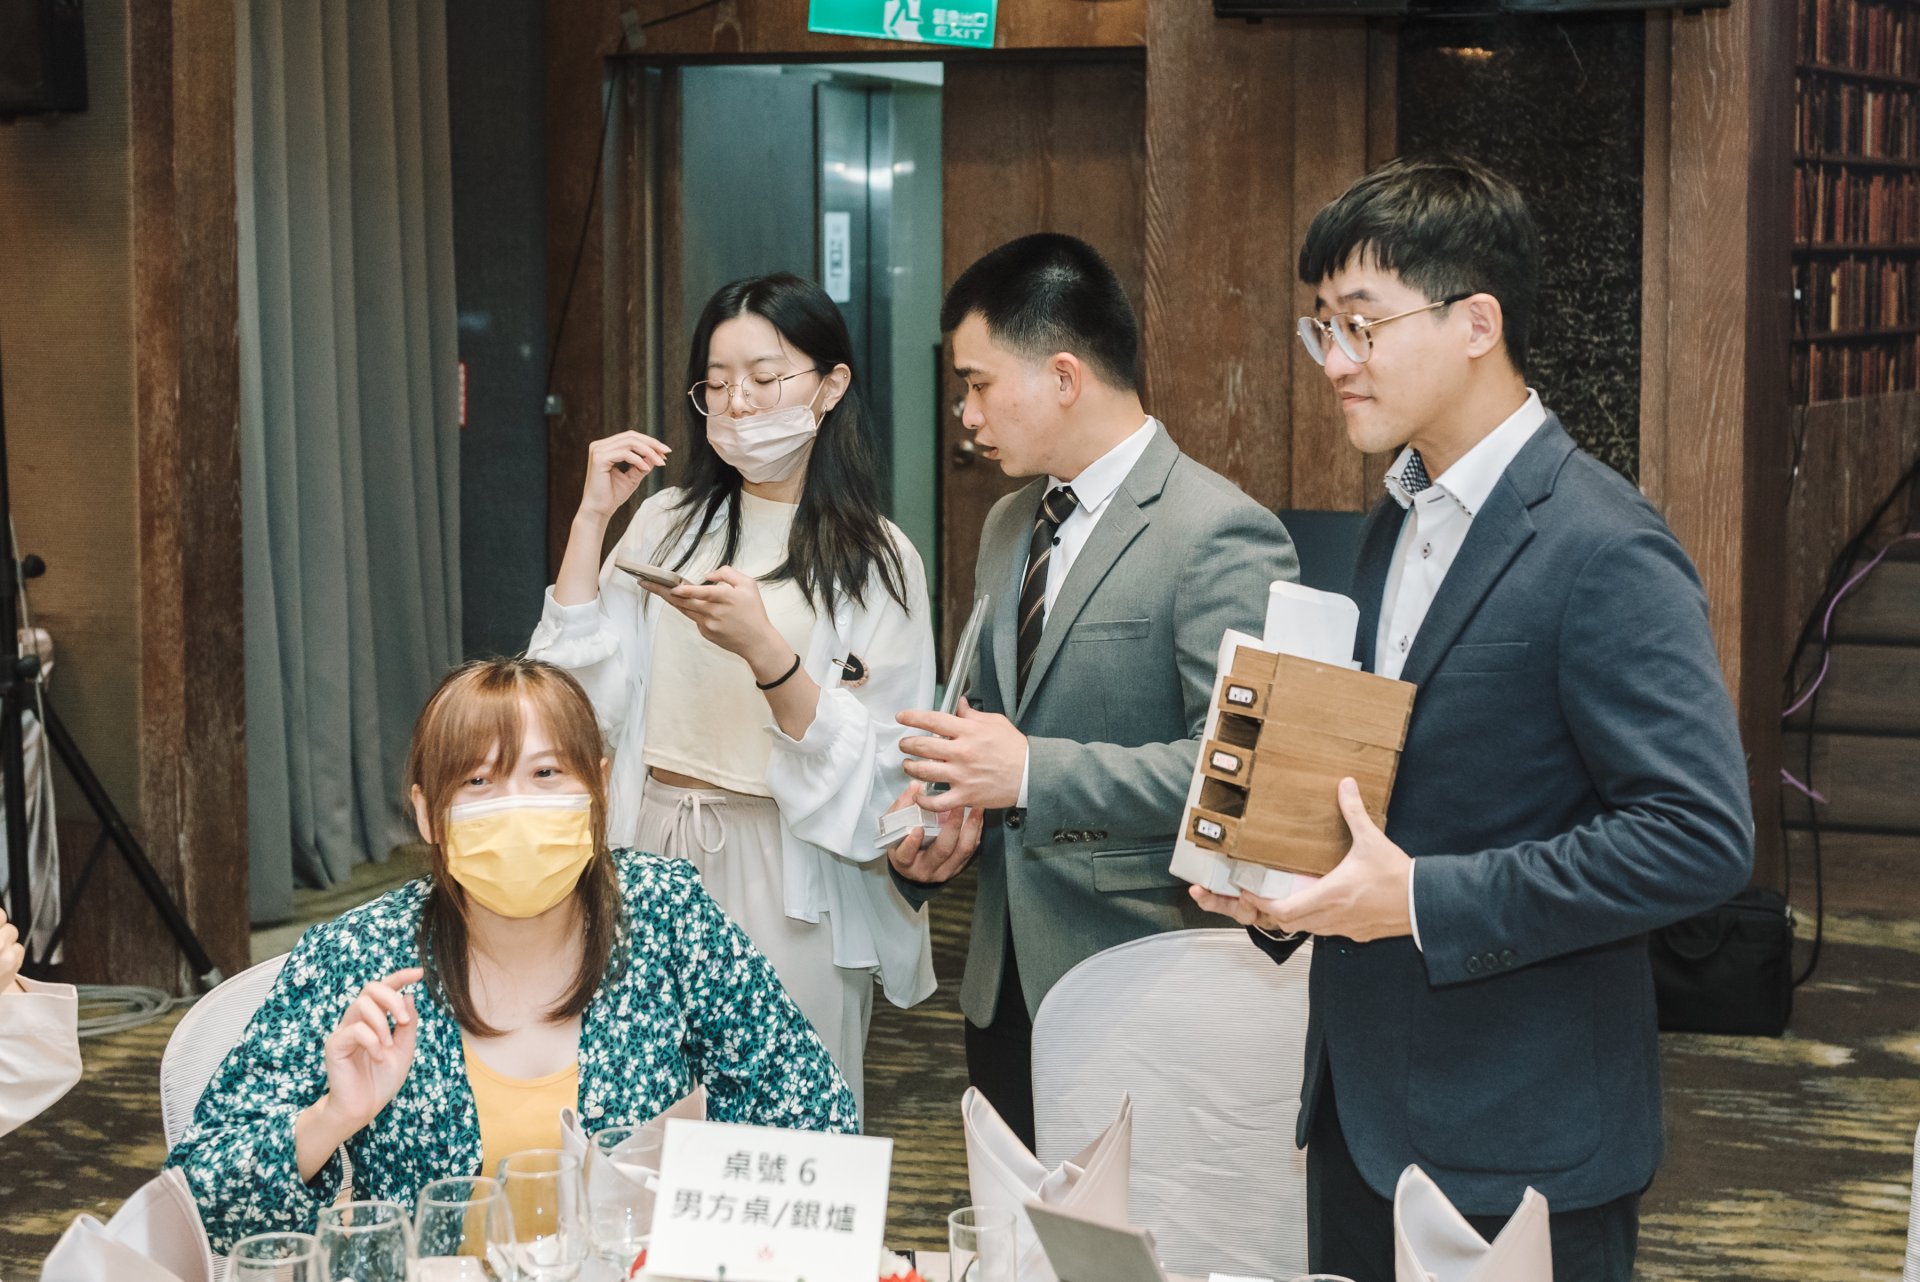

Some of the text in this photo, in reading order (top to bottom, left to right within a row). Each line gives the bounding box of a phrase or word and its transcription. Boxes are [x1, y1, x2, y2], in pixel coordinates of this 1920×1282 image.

[935, 25, 984, 40] EXIT
[724, 1150, 817, 1186] 桌號 6
[672, 1188, 857, 1233] 男方桌/銀爐
